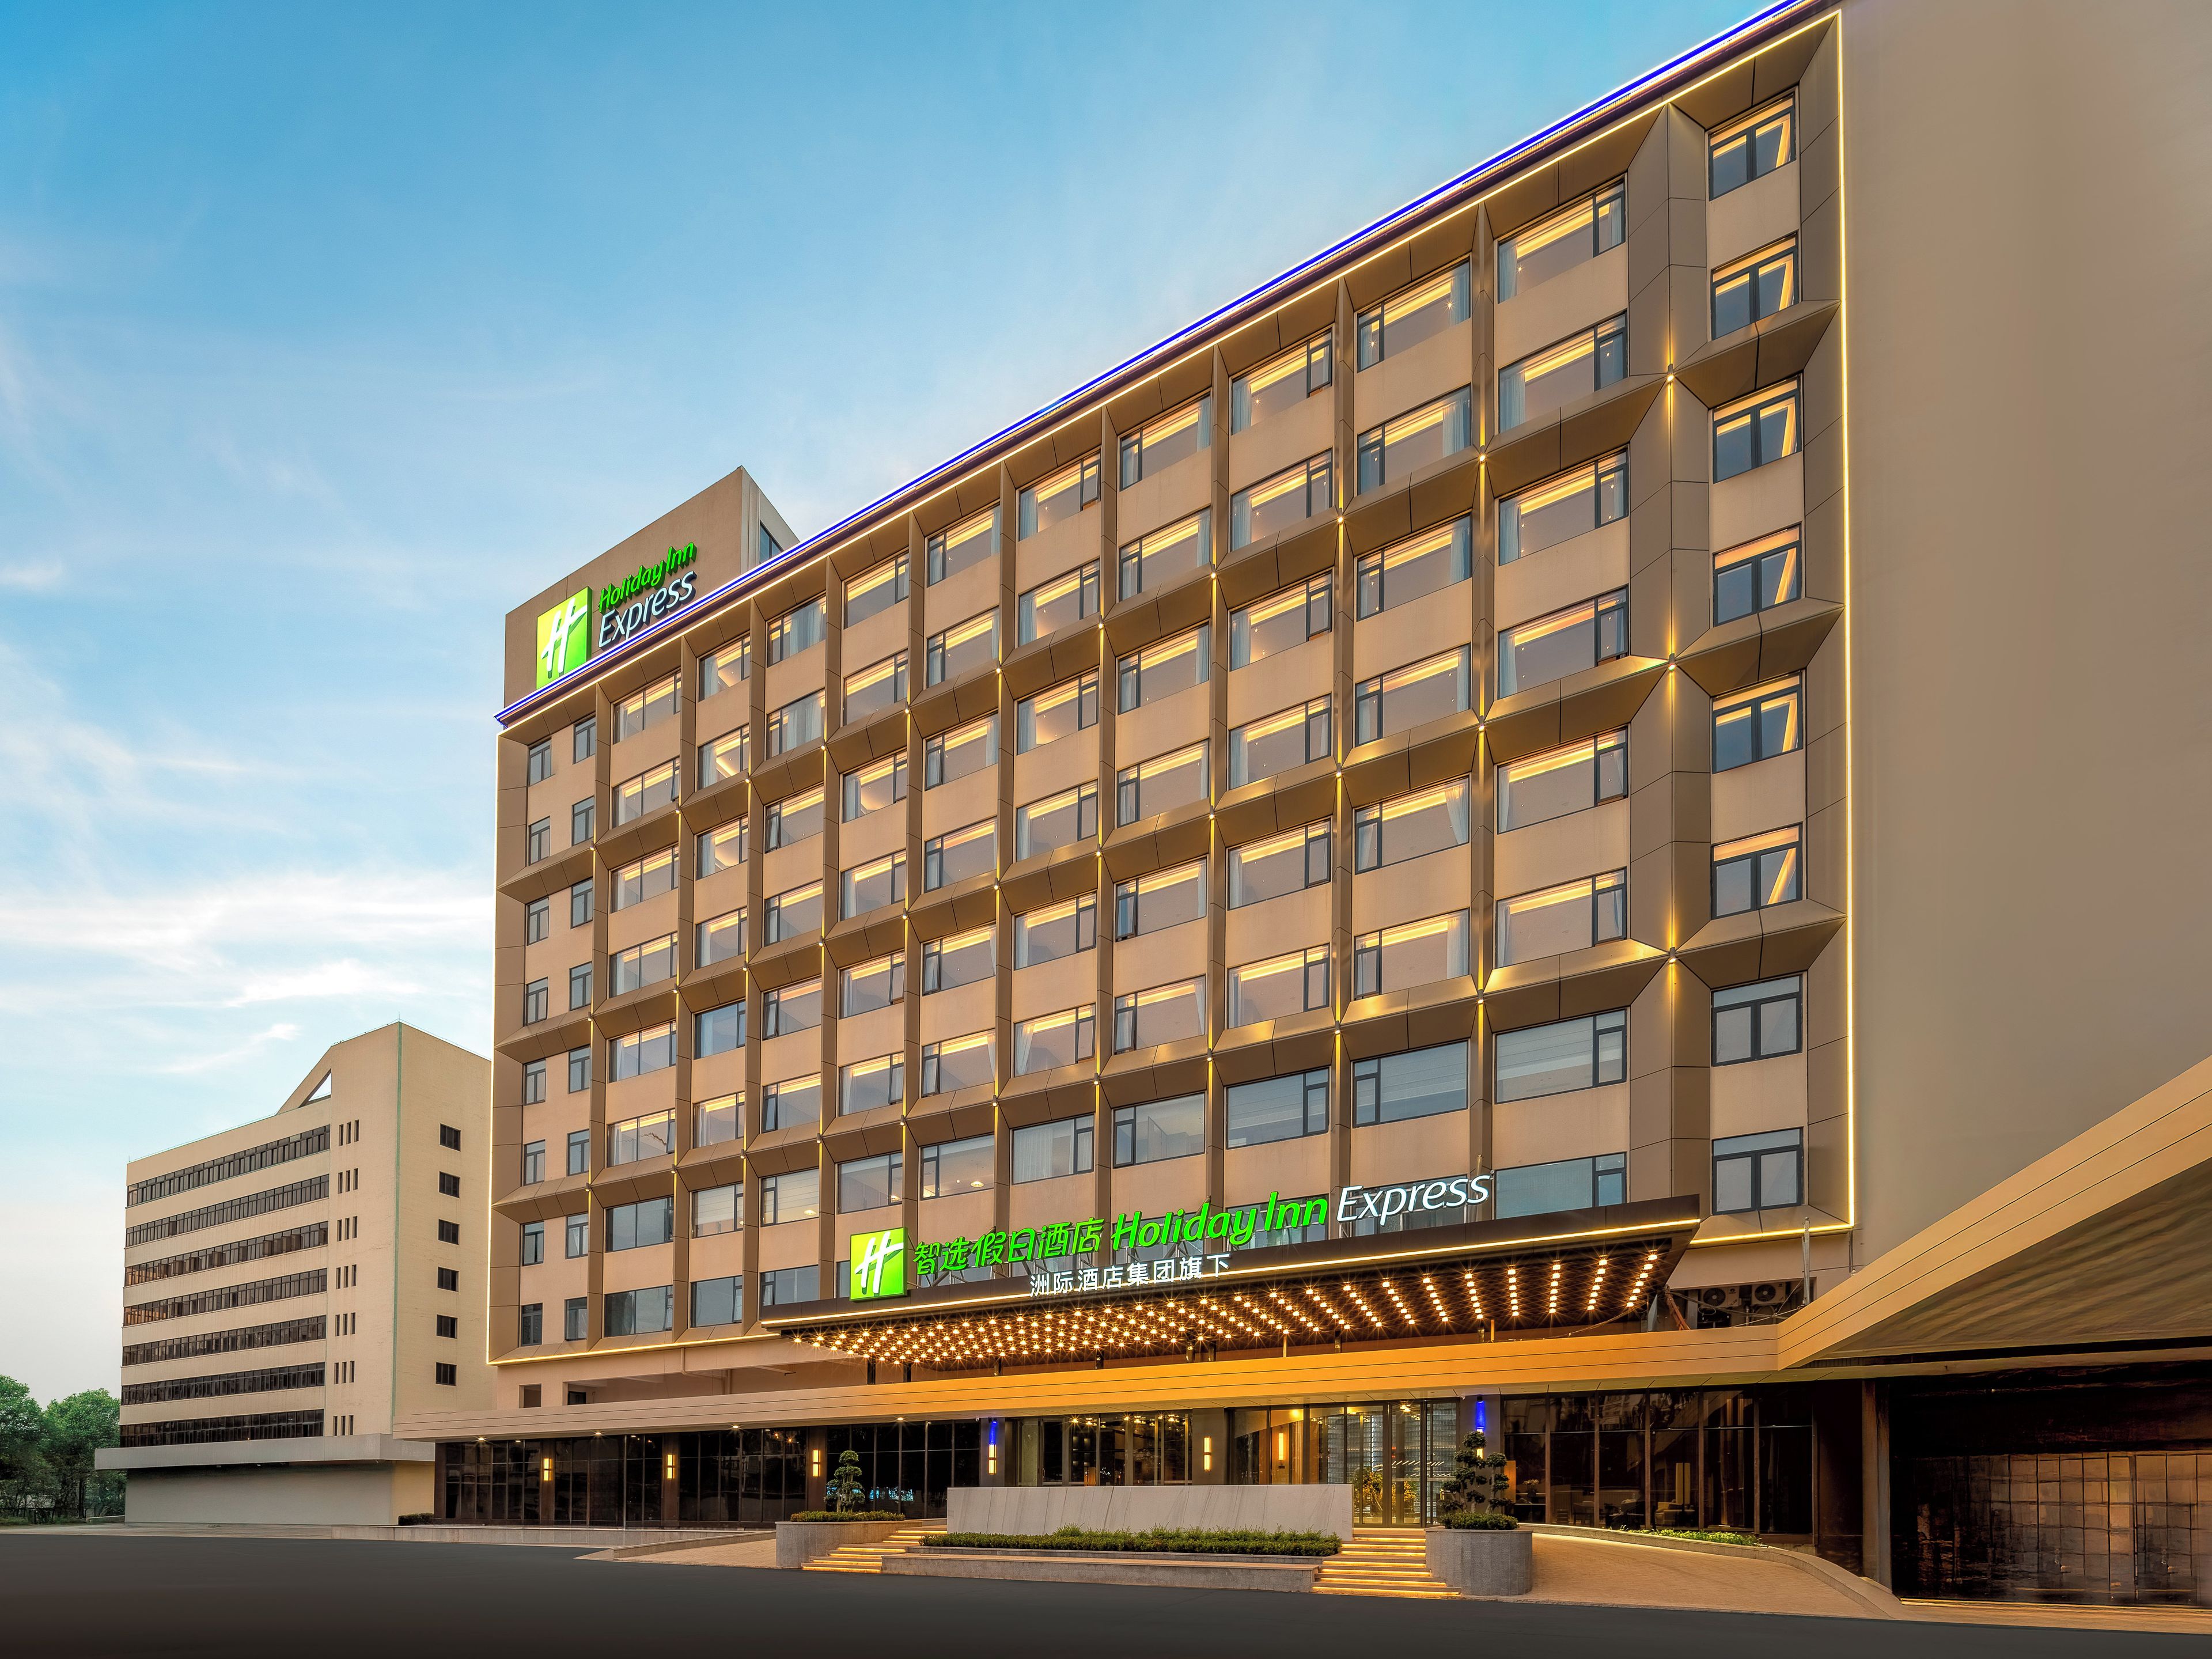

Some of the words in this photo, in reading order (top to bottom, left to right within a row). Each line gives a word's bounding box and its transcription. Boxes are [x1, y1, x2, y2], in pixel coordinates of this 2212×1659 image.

[598, 571, 696, 648] Express
[599, 560, 665, 613] Holiday
[666, 541, 695, 573] Inn
[913, 1217, 1105, 1275] 智选假日酒店
[1111, 1202, 1257, 1250] Holiday
[1264, 1191, 1328, 1232] Inn
[1336, 1173, 1491, 1225] Express
[1029, 1253, 1231, 1297] 洲际酒店集团旗下
